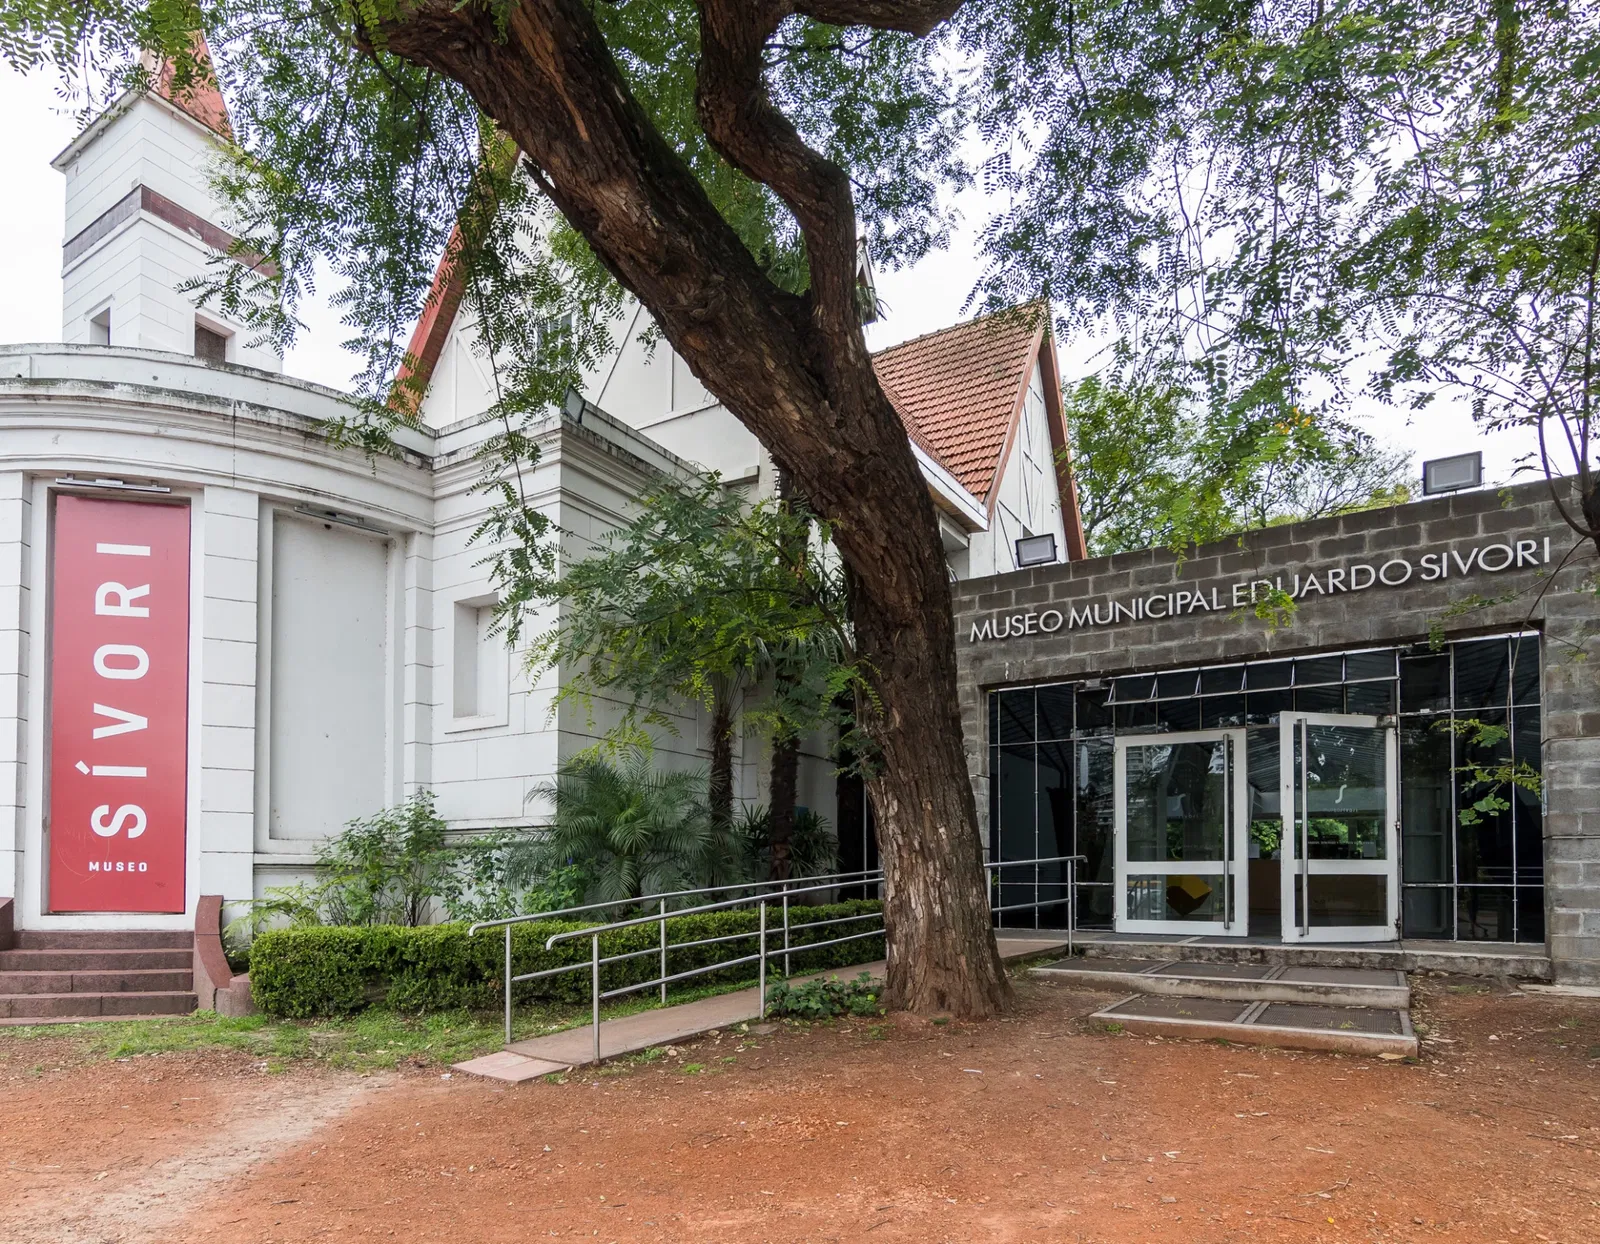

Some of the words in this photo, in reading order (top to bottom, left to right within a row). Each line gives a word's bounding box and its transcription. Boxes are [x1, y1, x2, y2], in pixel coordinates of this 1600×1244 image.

[969, 609, 1064, 643] MUSEO
[1068, 587, 1227, 629] MUNICIPAL
[1232, 559, 1413, 607] EDUARDO
[1419, 536, 1551, 581] SIVORI
[74, 542, 151, 839] SÍVORI
[88, 860, 149, 873] MUSEO
